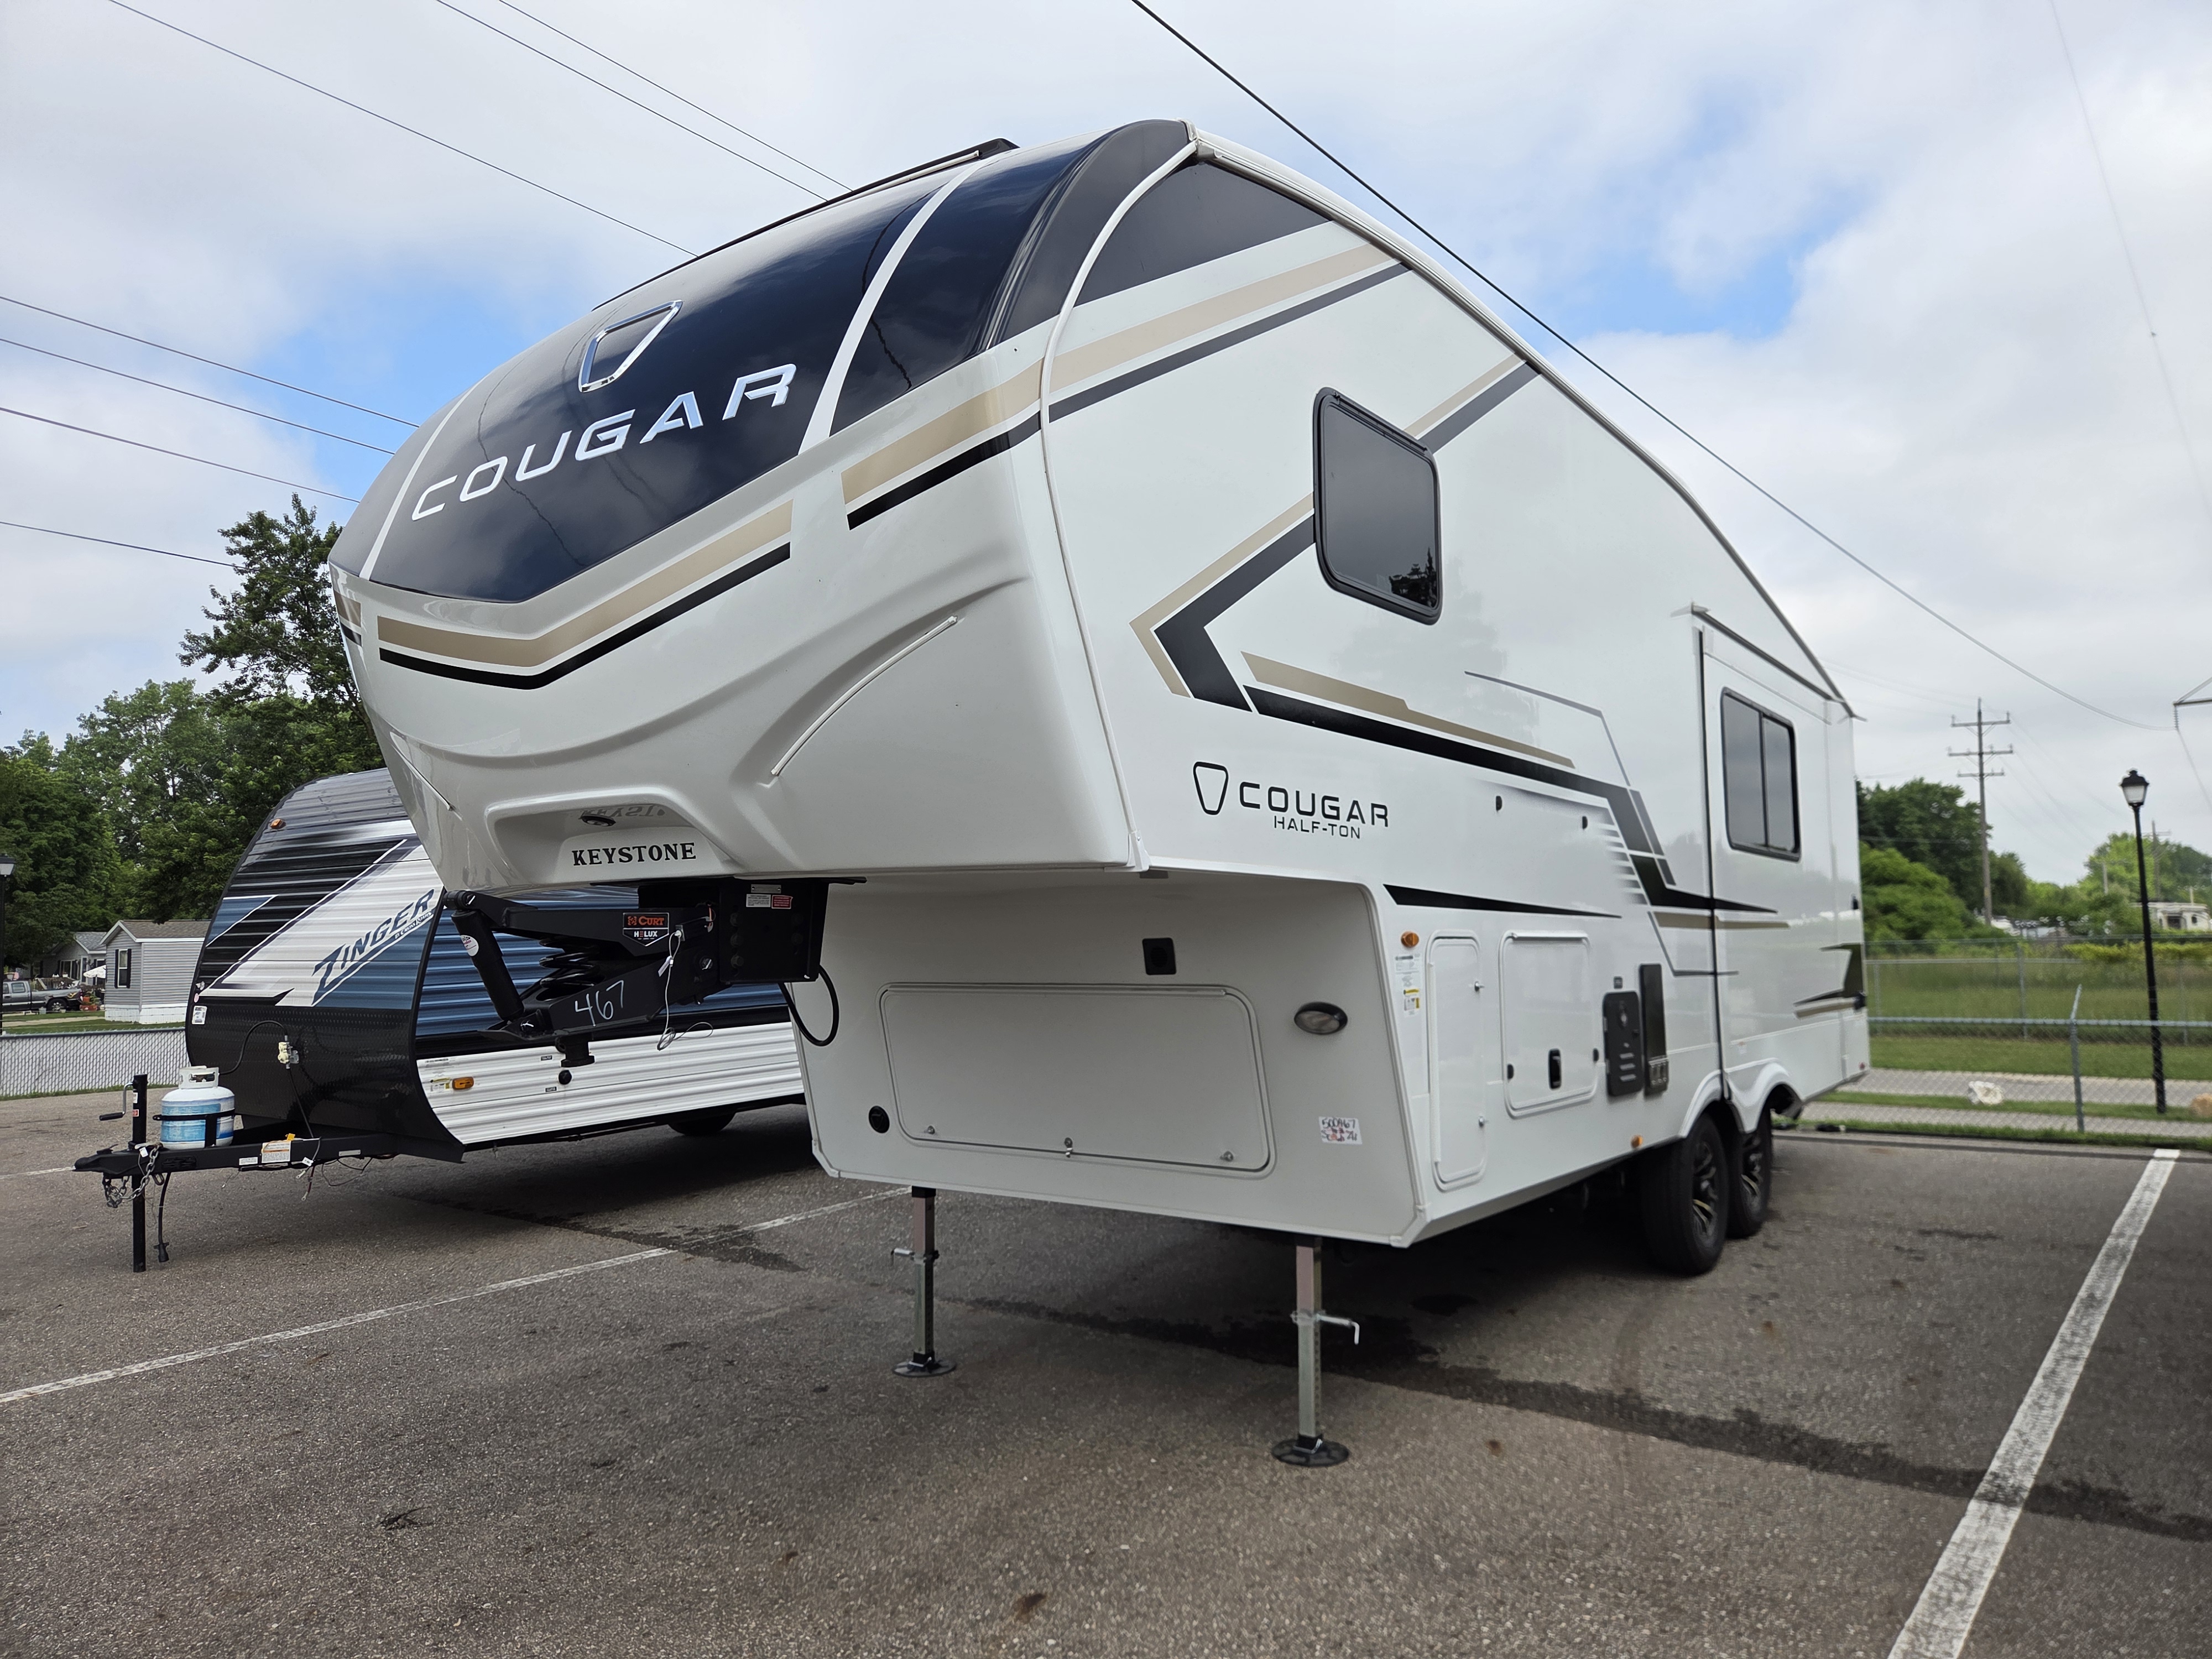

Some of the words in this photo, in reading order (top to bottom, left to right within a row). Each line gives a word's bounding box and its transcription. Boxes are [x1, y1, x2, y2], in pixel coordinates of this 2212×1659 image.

[412, 363, 797, 521] COUGAR
[1239, 781, 1389, 827] COUGAR
[1274, 816, 1360, 839] HALF-TON
[572, 842, 696, 866] KEYSTONE
[638, 916, 665, 926] CURT
[311, 889, 435, 1005] ZINGER
[575, 980, 624, 1027] 467
